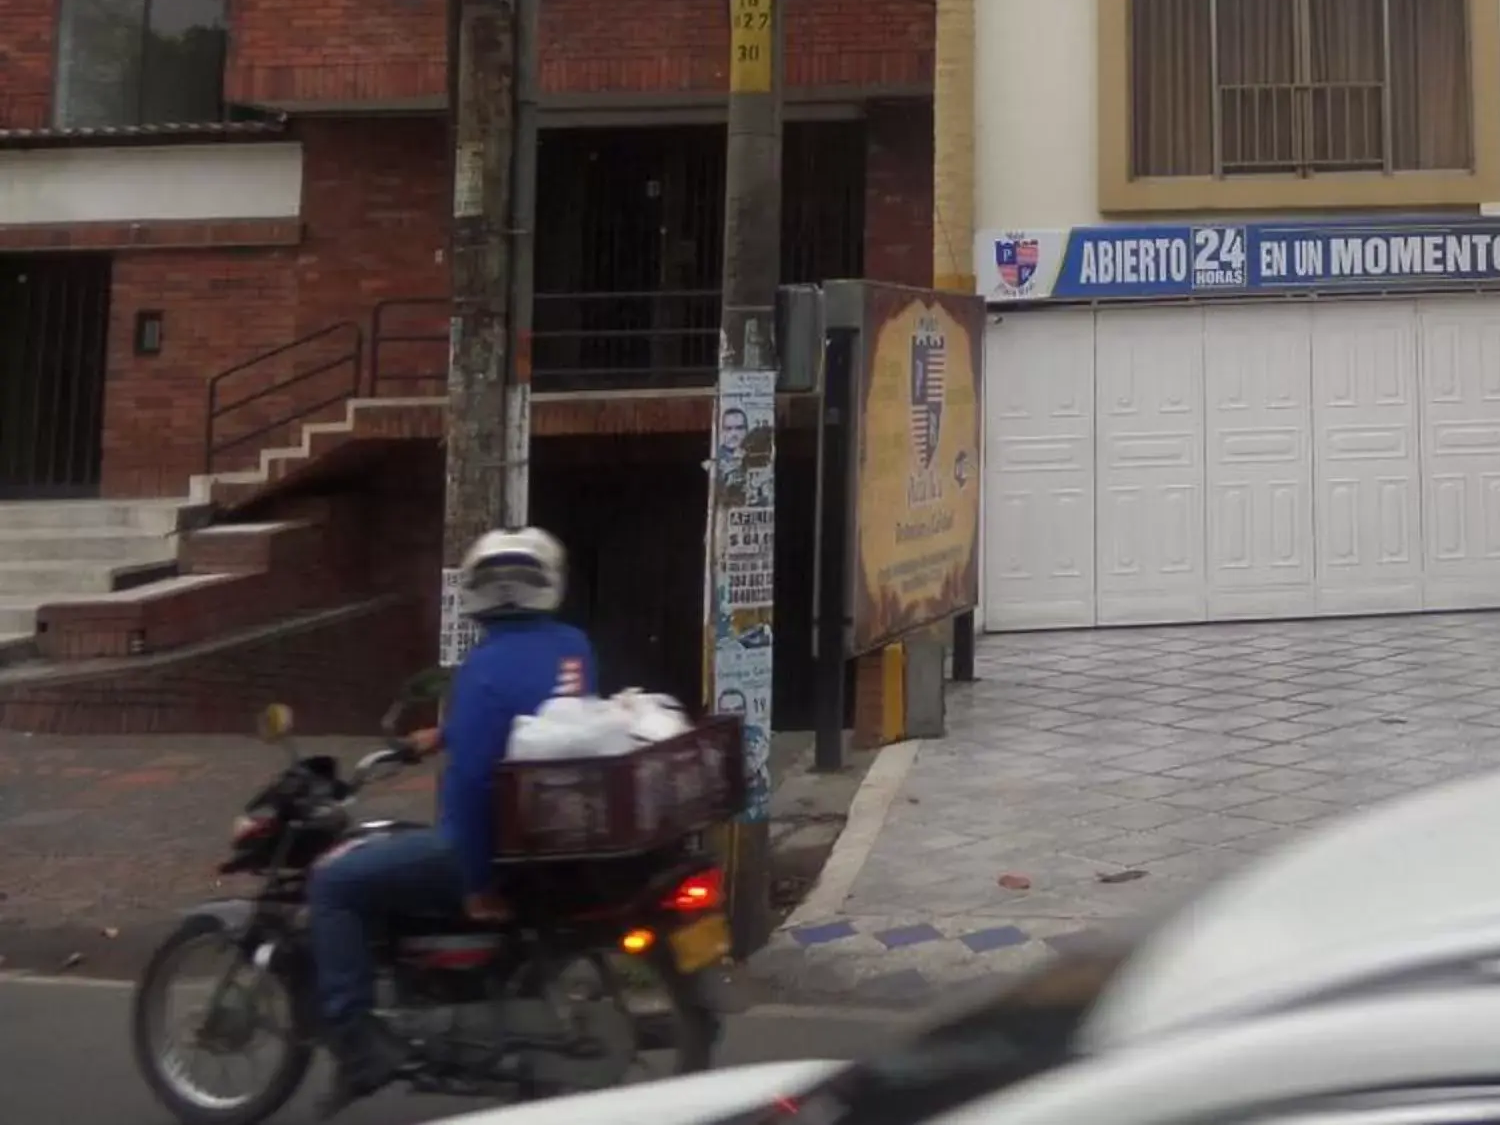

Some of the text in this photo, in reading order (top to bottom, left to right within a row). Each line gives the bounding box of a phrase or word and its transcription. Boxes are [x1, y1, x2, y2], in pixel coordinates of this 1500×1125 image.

[1081, 238, 1187, 284] ABIERTO
[1195, 228, 1245, 269] 24
[1259, 240, 1287, 277] EN
[1294, 239, 1323, 275] UN
[1196, 270, 1242, 285] HORAS
